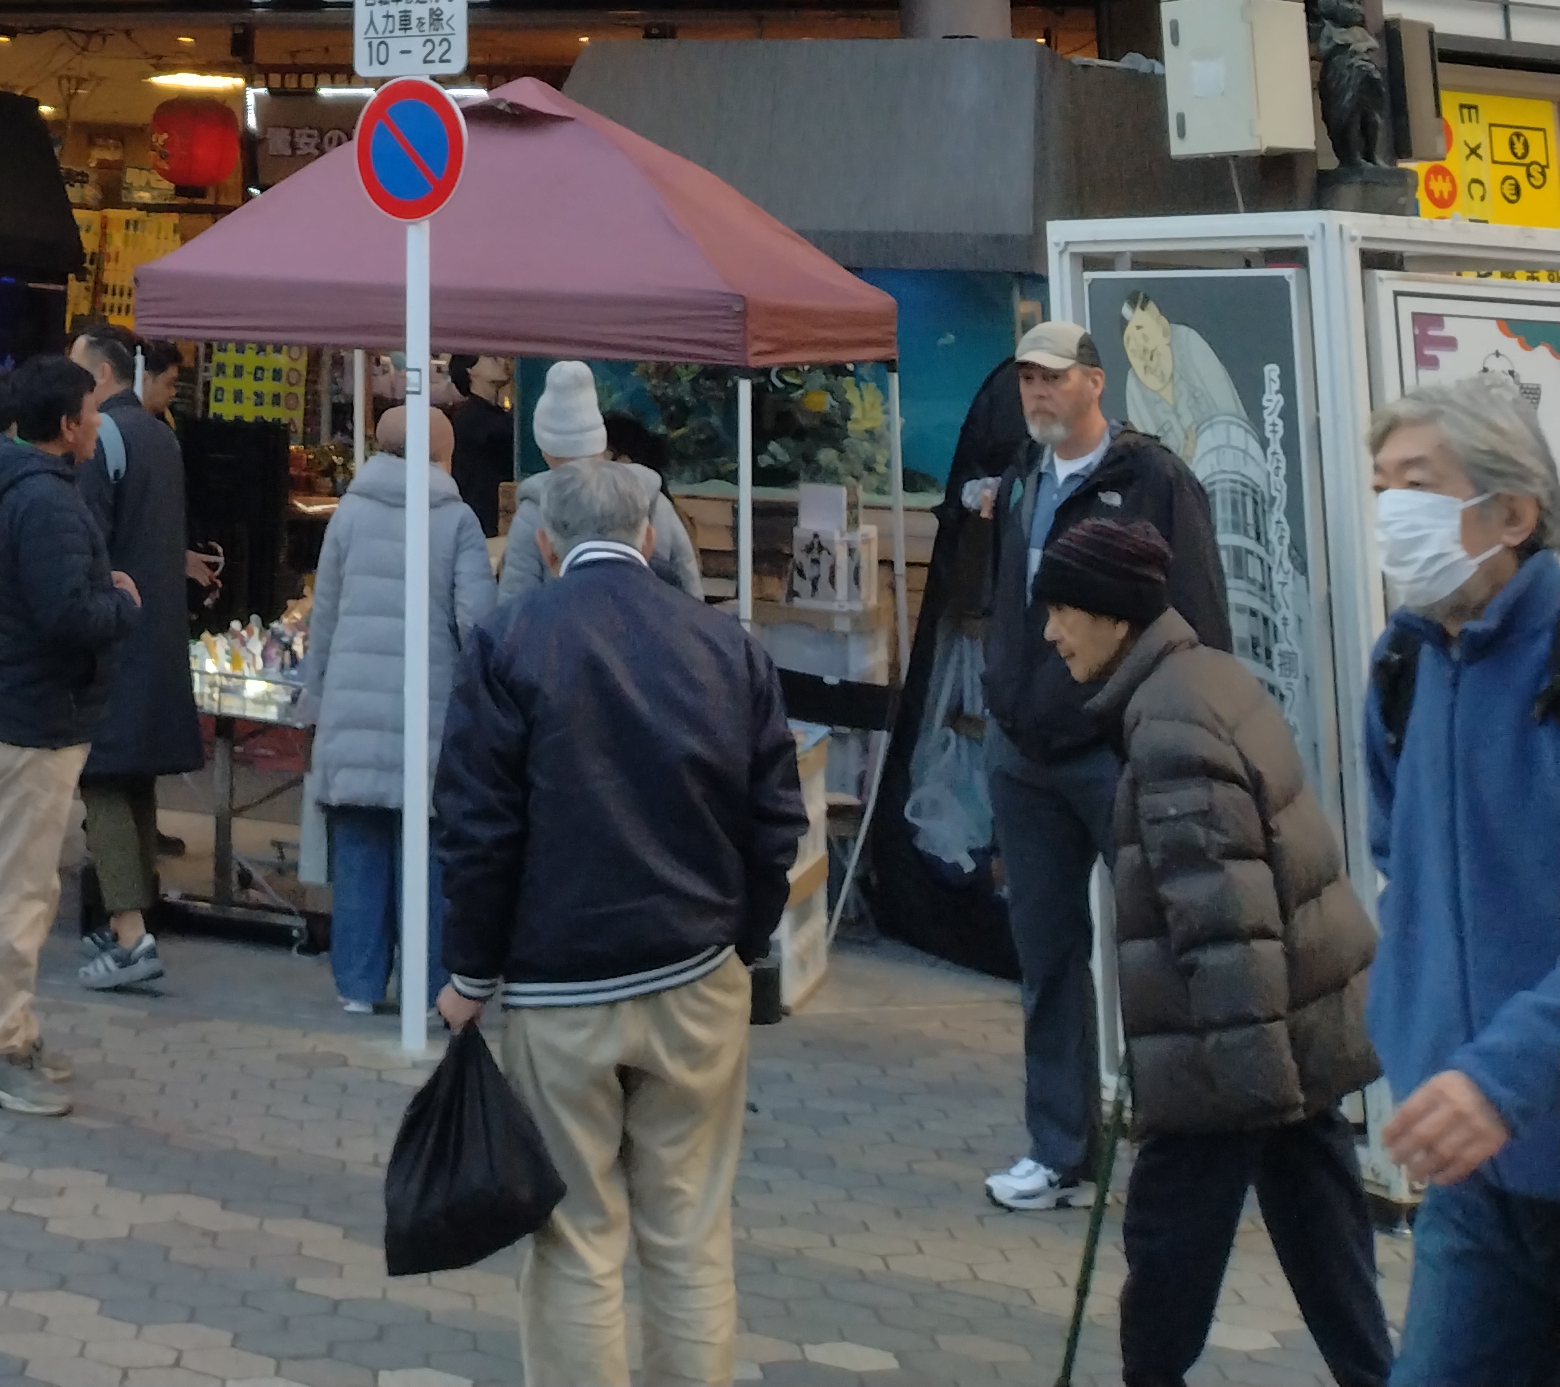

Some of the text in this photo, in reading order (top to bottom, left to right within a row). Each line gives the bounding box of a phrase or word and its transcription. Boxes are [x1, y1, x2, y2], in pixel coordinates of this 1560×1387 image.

[363, 7, 456, 36] 人力車を除く
[1458, 102, 1490, 224] EXC
